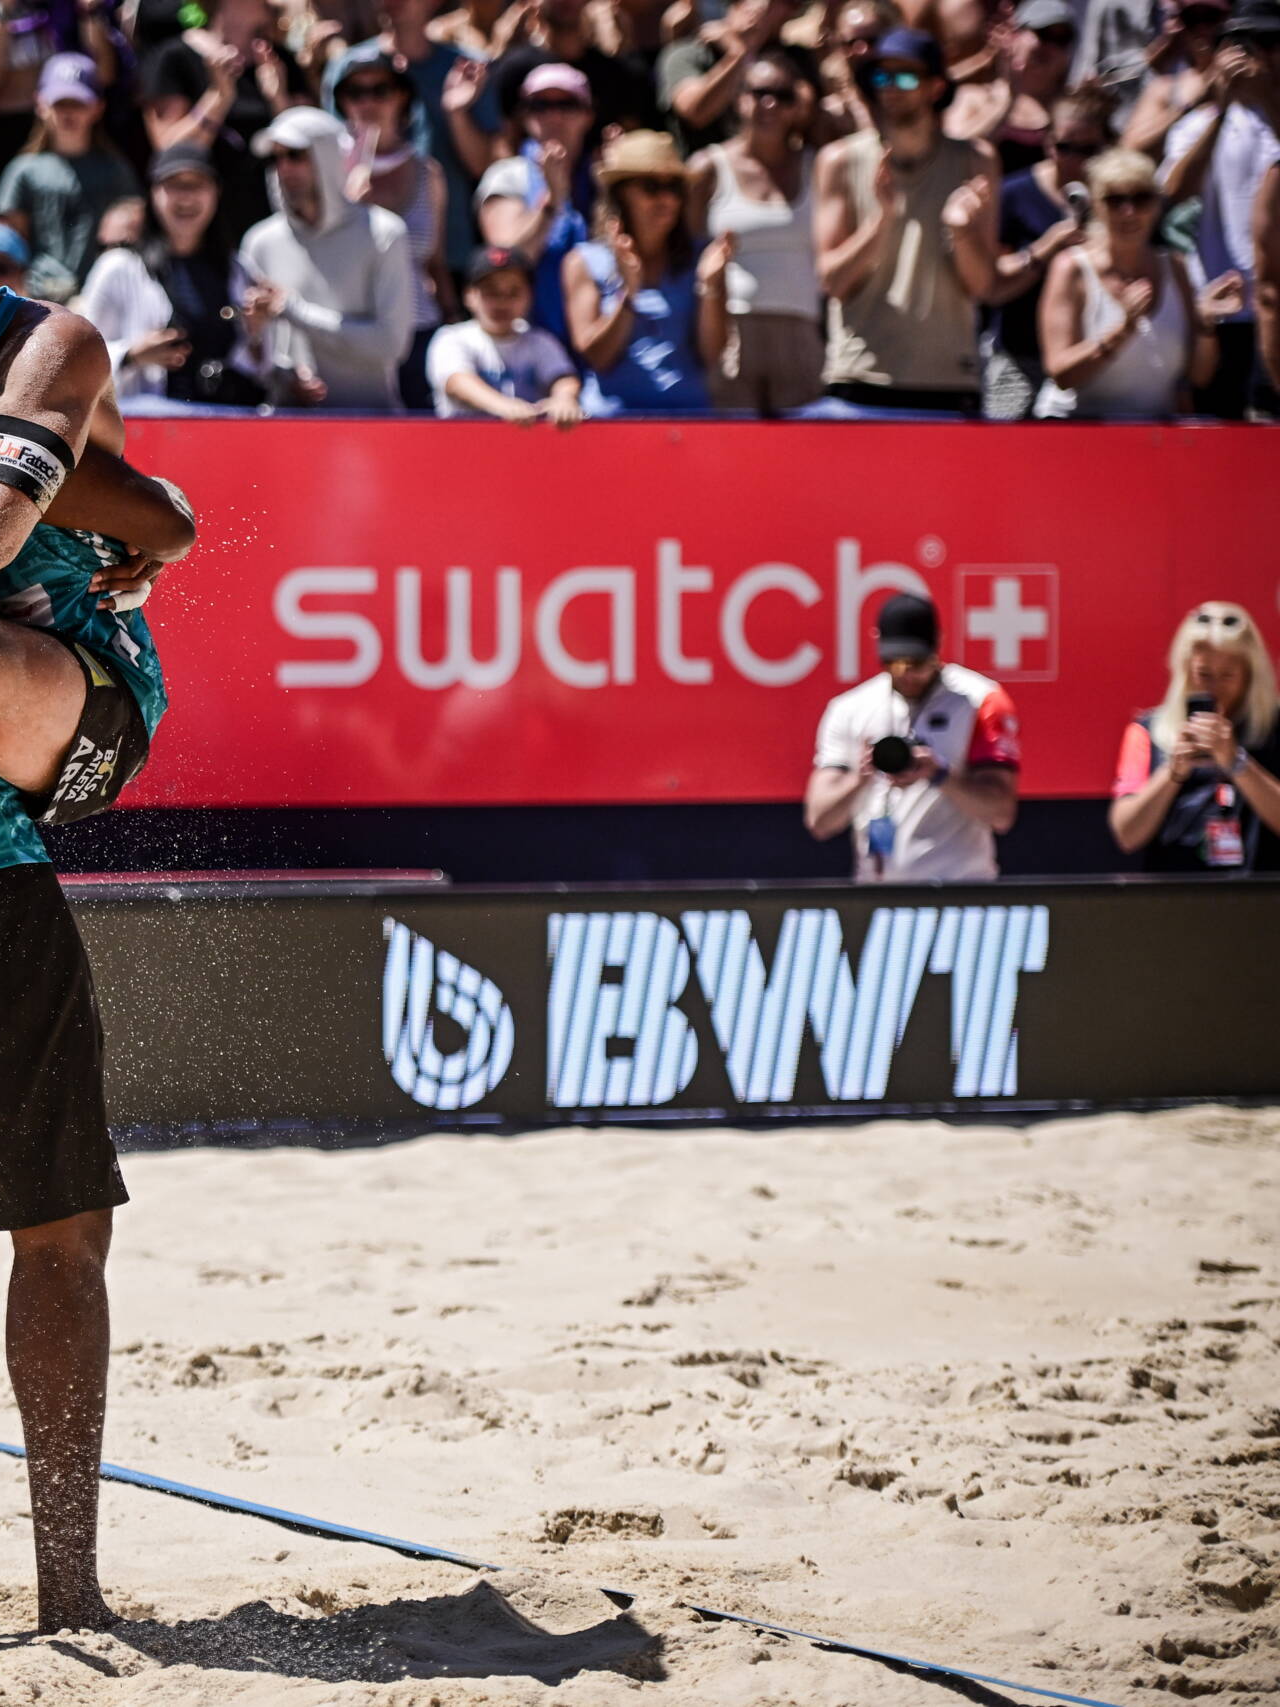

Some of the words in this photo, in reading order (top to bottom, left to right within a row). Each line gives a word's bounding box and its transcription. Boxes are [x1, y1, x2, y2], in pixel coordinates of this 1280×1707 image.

[272, 536, 933, 690] swatch
[64, 749, 104, 801] ATLETA
[547, 905, 1049, 1107] BWT
